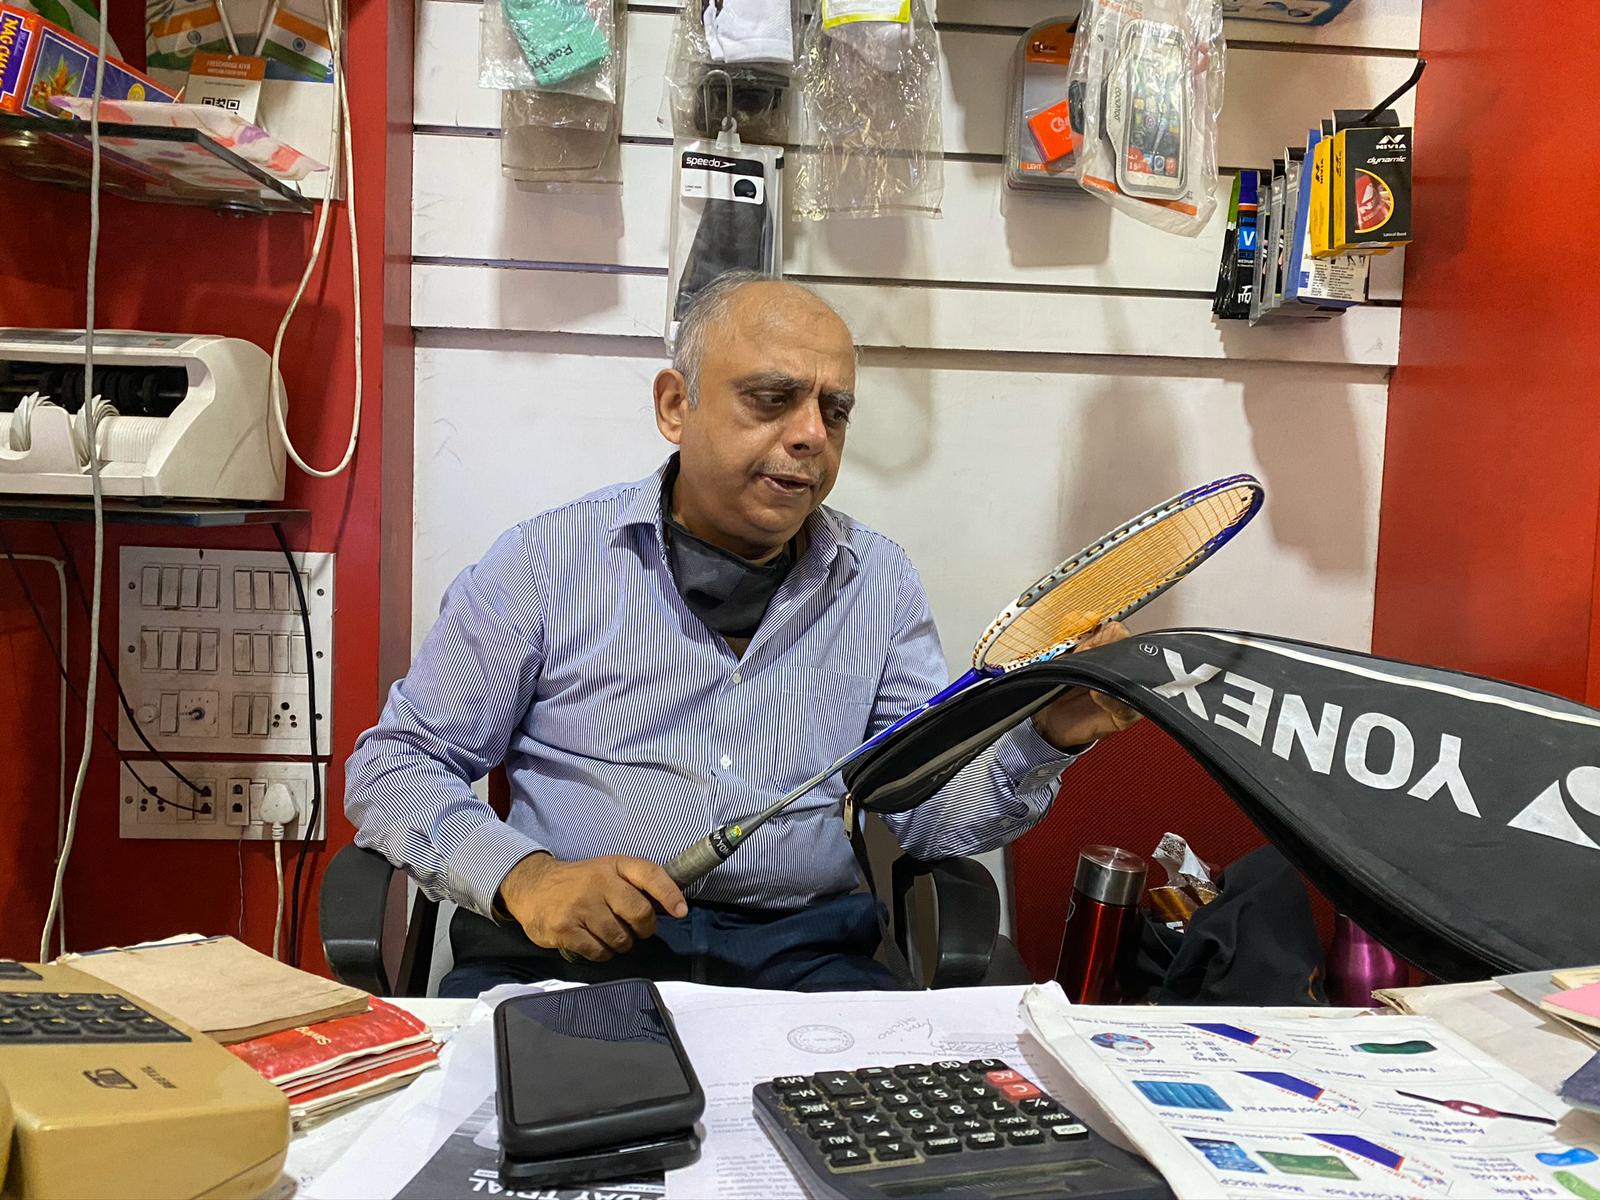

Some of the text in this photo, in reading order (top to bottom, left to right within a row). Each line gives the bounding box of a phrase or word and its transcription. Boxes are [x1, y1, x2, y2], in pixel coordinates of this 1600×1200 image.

[686, 156, 720, 168] speedo
[1367, 155, 1407, 165] dynamic
[1152, 648, 1481, 818] YONEX
[940, 1061, 961, 1070] 00
[981, 1059, 995, 1068] 0
[918, 1076, 933, 1086] 2
[959, 1074, 971, 1083] 1
[992, 1072, 1014, 1081] AC
[880, 1080, 896, 1090] 3
[1012, 1085, 1028, 1094] C
[933, 1088, 948, 1099] 5
[973, 1087, 986, 1097] 4
[894, 1094, 909, 1104] 6
[801, 1103, 829, 1114] MRC
[950, 1104, 966, 1115] 8
[992, 1101, 1005, 1112] 7
[908, 1109, 924, 1120] 9
[828, 1136, 853, 1145] MU
